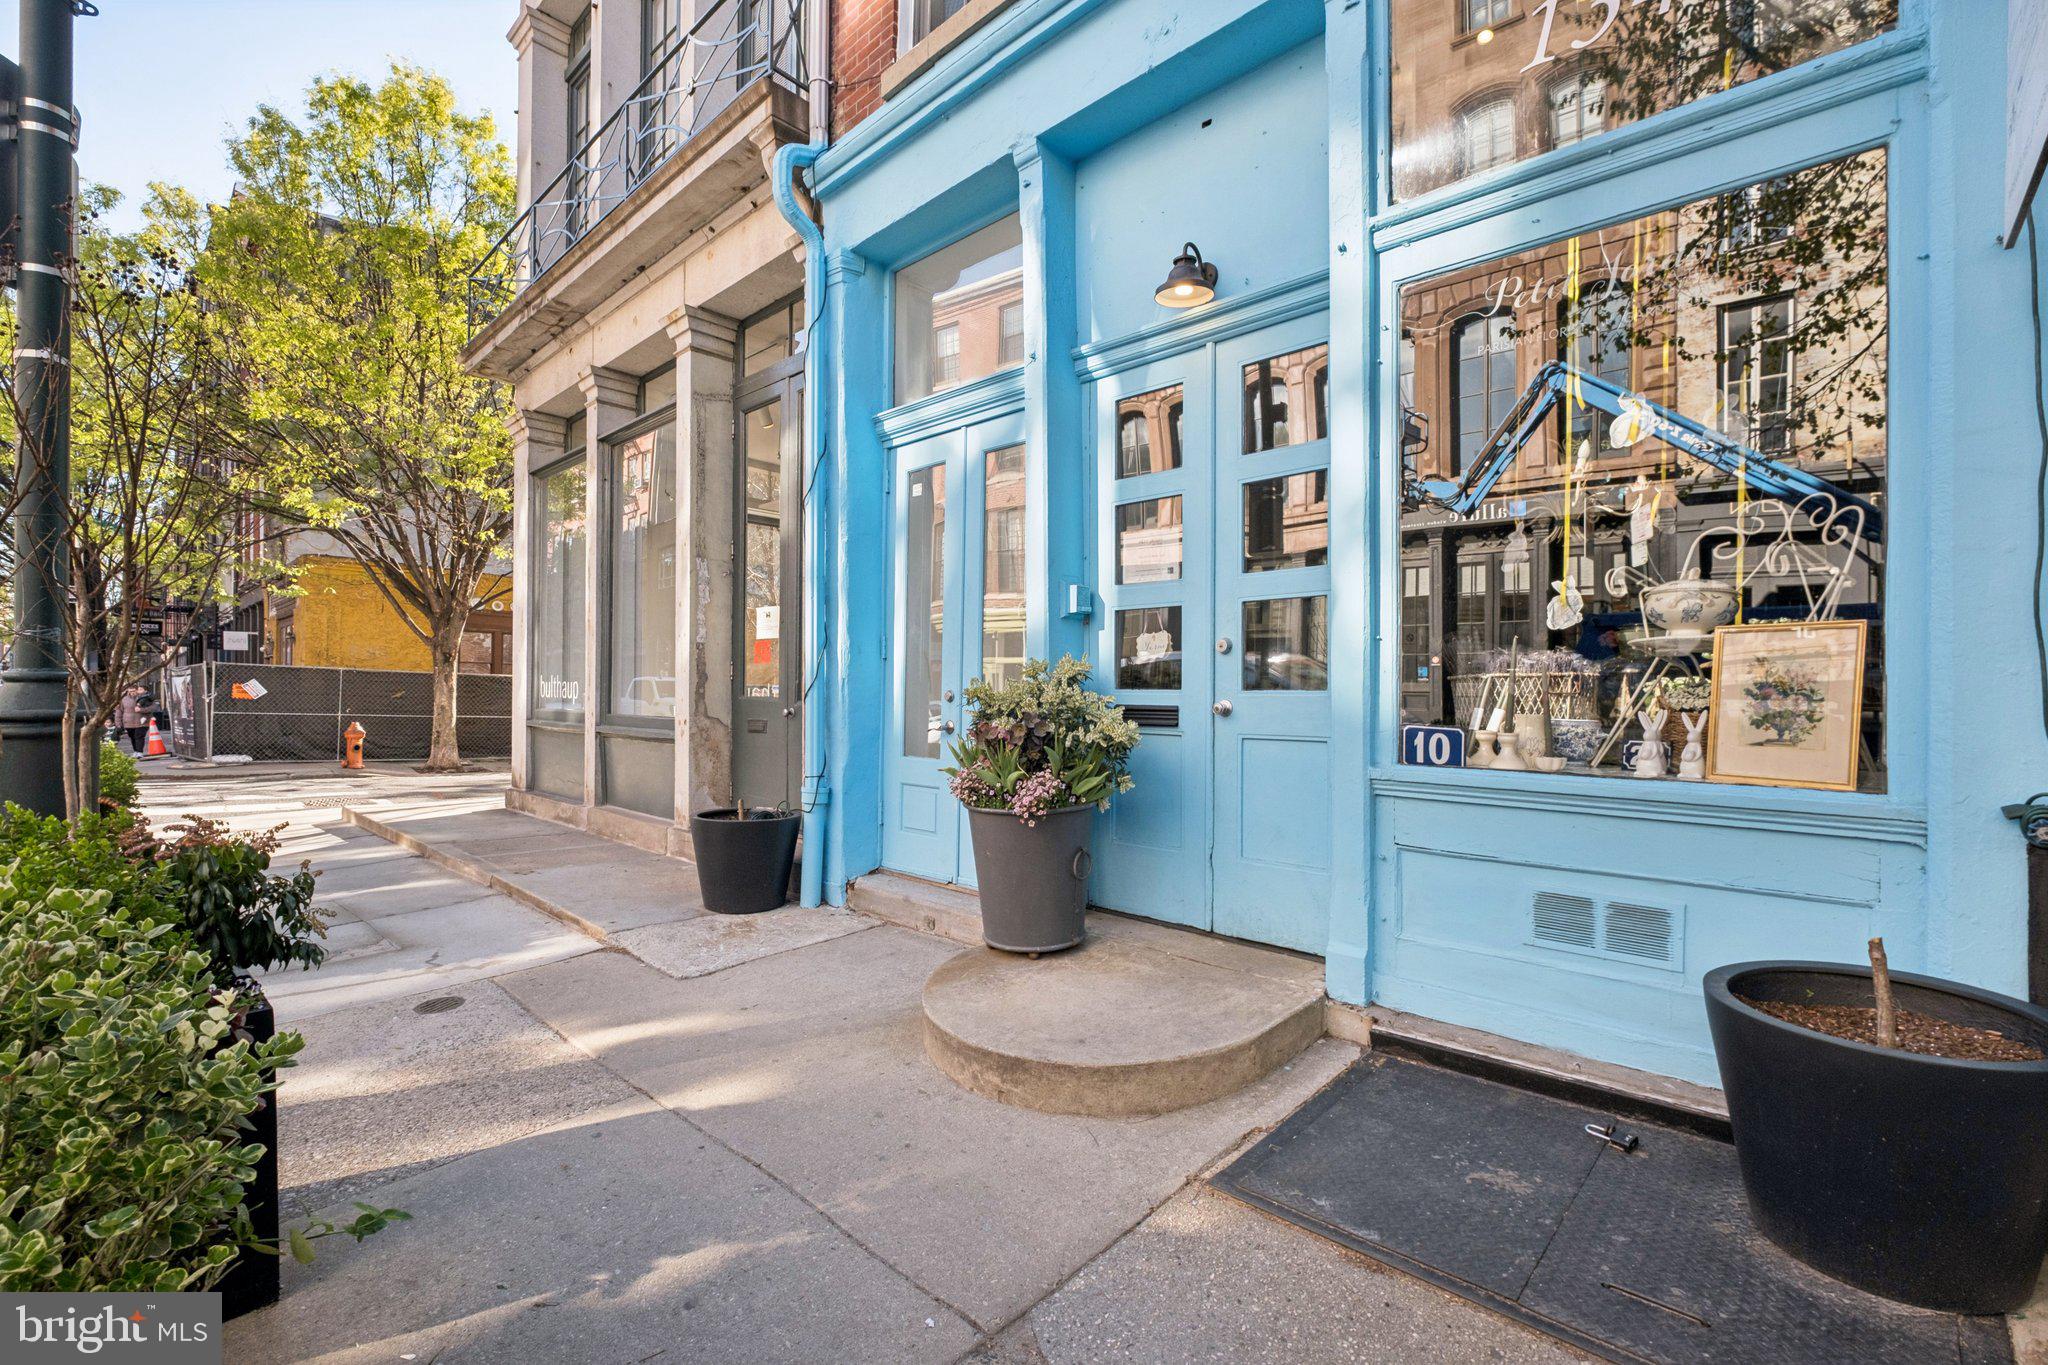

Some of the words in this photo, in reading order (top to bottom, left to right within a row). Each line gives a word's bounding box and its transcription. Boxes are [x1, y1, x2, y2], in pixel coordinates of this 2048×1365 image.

[1480, 270, 1576, 318] Petit
[1477, 334, 1533, 356] PARISIAN
[540, 674, 579, 705] bulthaup
[1414, 731, 1451, 765] 10
